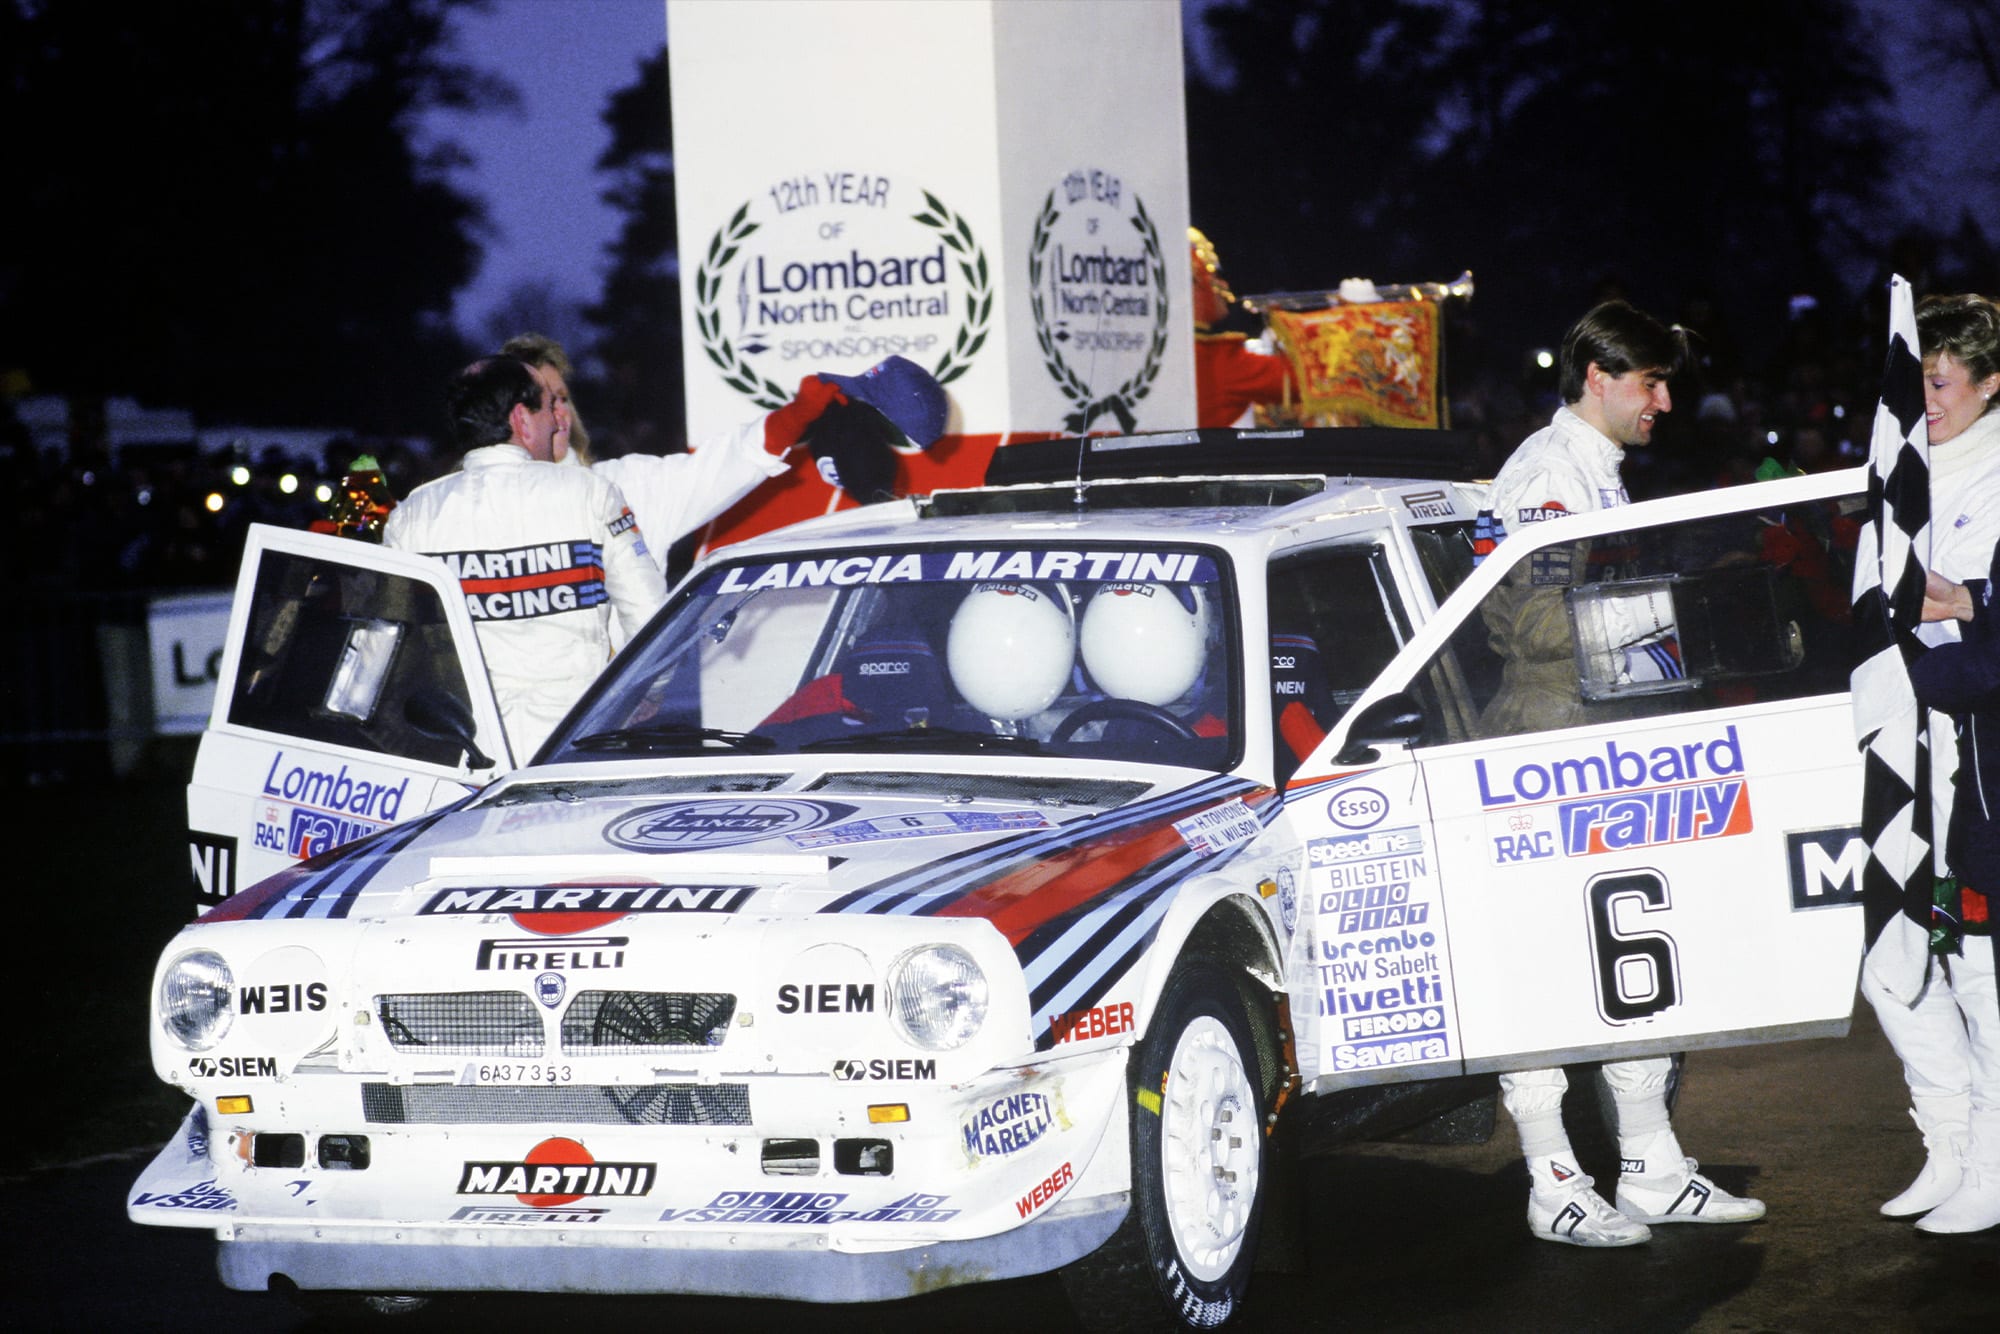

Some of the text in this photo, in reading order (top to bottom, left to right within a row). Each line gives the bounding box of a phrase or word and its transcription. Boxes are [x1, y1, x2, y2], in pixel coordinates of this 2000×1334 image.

[770, 173, 890, 214] 12th YEAR
[818, 222, 845, 240] OF
[757, 245, 946, 294] Lombard
[1058, 243, 1147, 287] Lombard
[759, 290, 949, 325] North Central
[1061, 288, 1149, 317] North Central
[780, 334, 938, 361] SPONSORSHIP
[1401, 490, 1456, 518] PIRELLI
[1520, 508, 1568, 521] MART
[717, 551, 1200, 595] LANCIA MARTINI
[469, 584, 577, 619] ACING
[1474, 725, 1745, 807] Lombard
[263, 751, 409, 822] Lombard
[255, 822, 286, 850] RAC
[901, 816, 923, 828] 6
[1221, 819, 1260, 842] WILSON
[1493, 779, 1745, 864] RAC rally
[1309, 833, 1408, 862] speedline
[1330, 857, 1427, 889] BILSTEIN
[433, 887, 748, 912] MARTINI
[1322, 884, 1408, 912] OLIO
[1344, 904, 1425, 932] FIAT
[475, 936, 629, 970] PIRELLI
[1322, 930, 1436, 960] brembo
[1583, 867, 1683, 1028] 6
[1318, 951, 1440, 986] TRW Sabelt
[240, 982, 328, 1015] SIEM
[776, 984, 875, 1014] SIEM
[1050, 1001, 1135, 1045] WEBER
[1346, 1008, 1441, 1040] FERODO
[219, 1057, 278, 1077] SIEM
[1335, 1037, 1446, 1070] Savara
[869, 1059, 936, 1080] SIEM
[465, 1166, 648, 1195] MARTINI
[1015, 1161, 1074, 1219] WEBER
[448, 1206, 611, 1223] PIRELLI
[711, 1192, 841, 1209] OLIO
